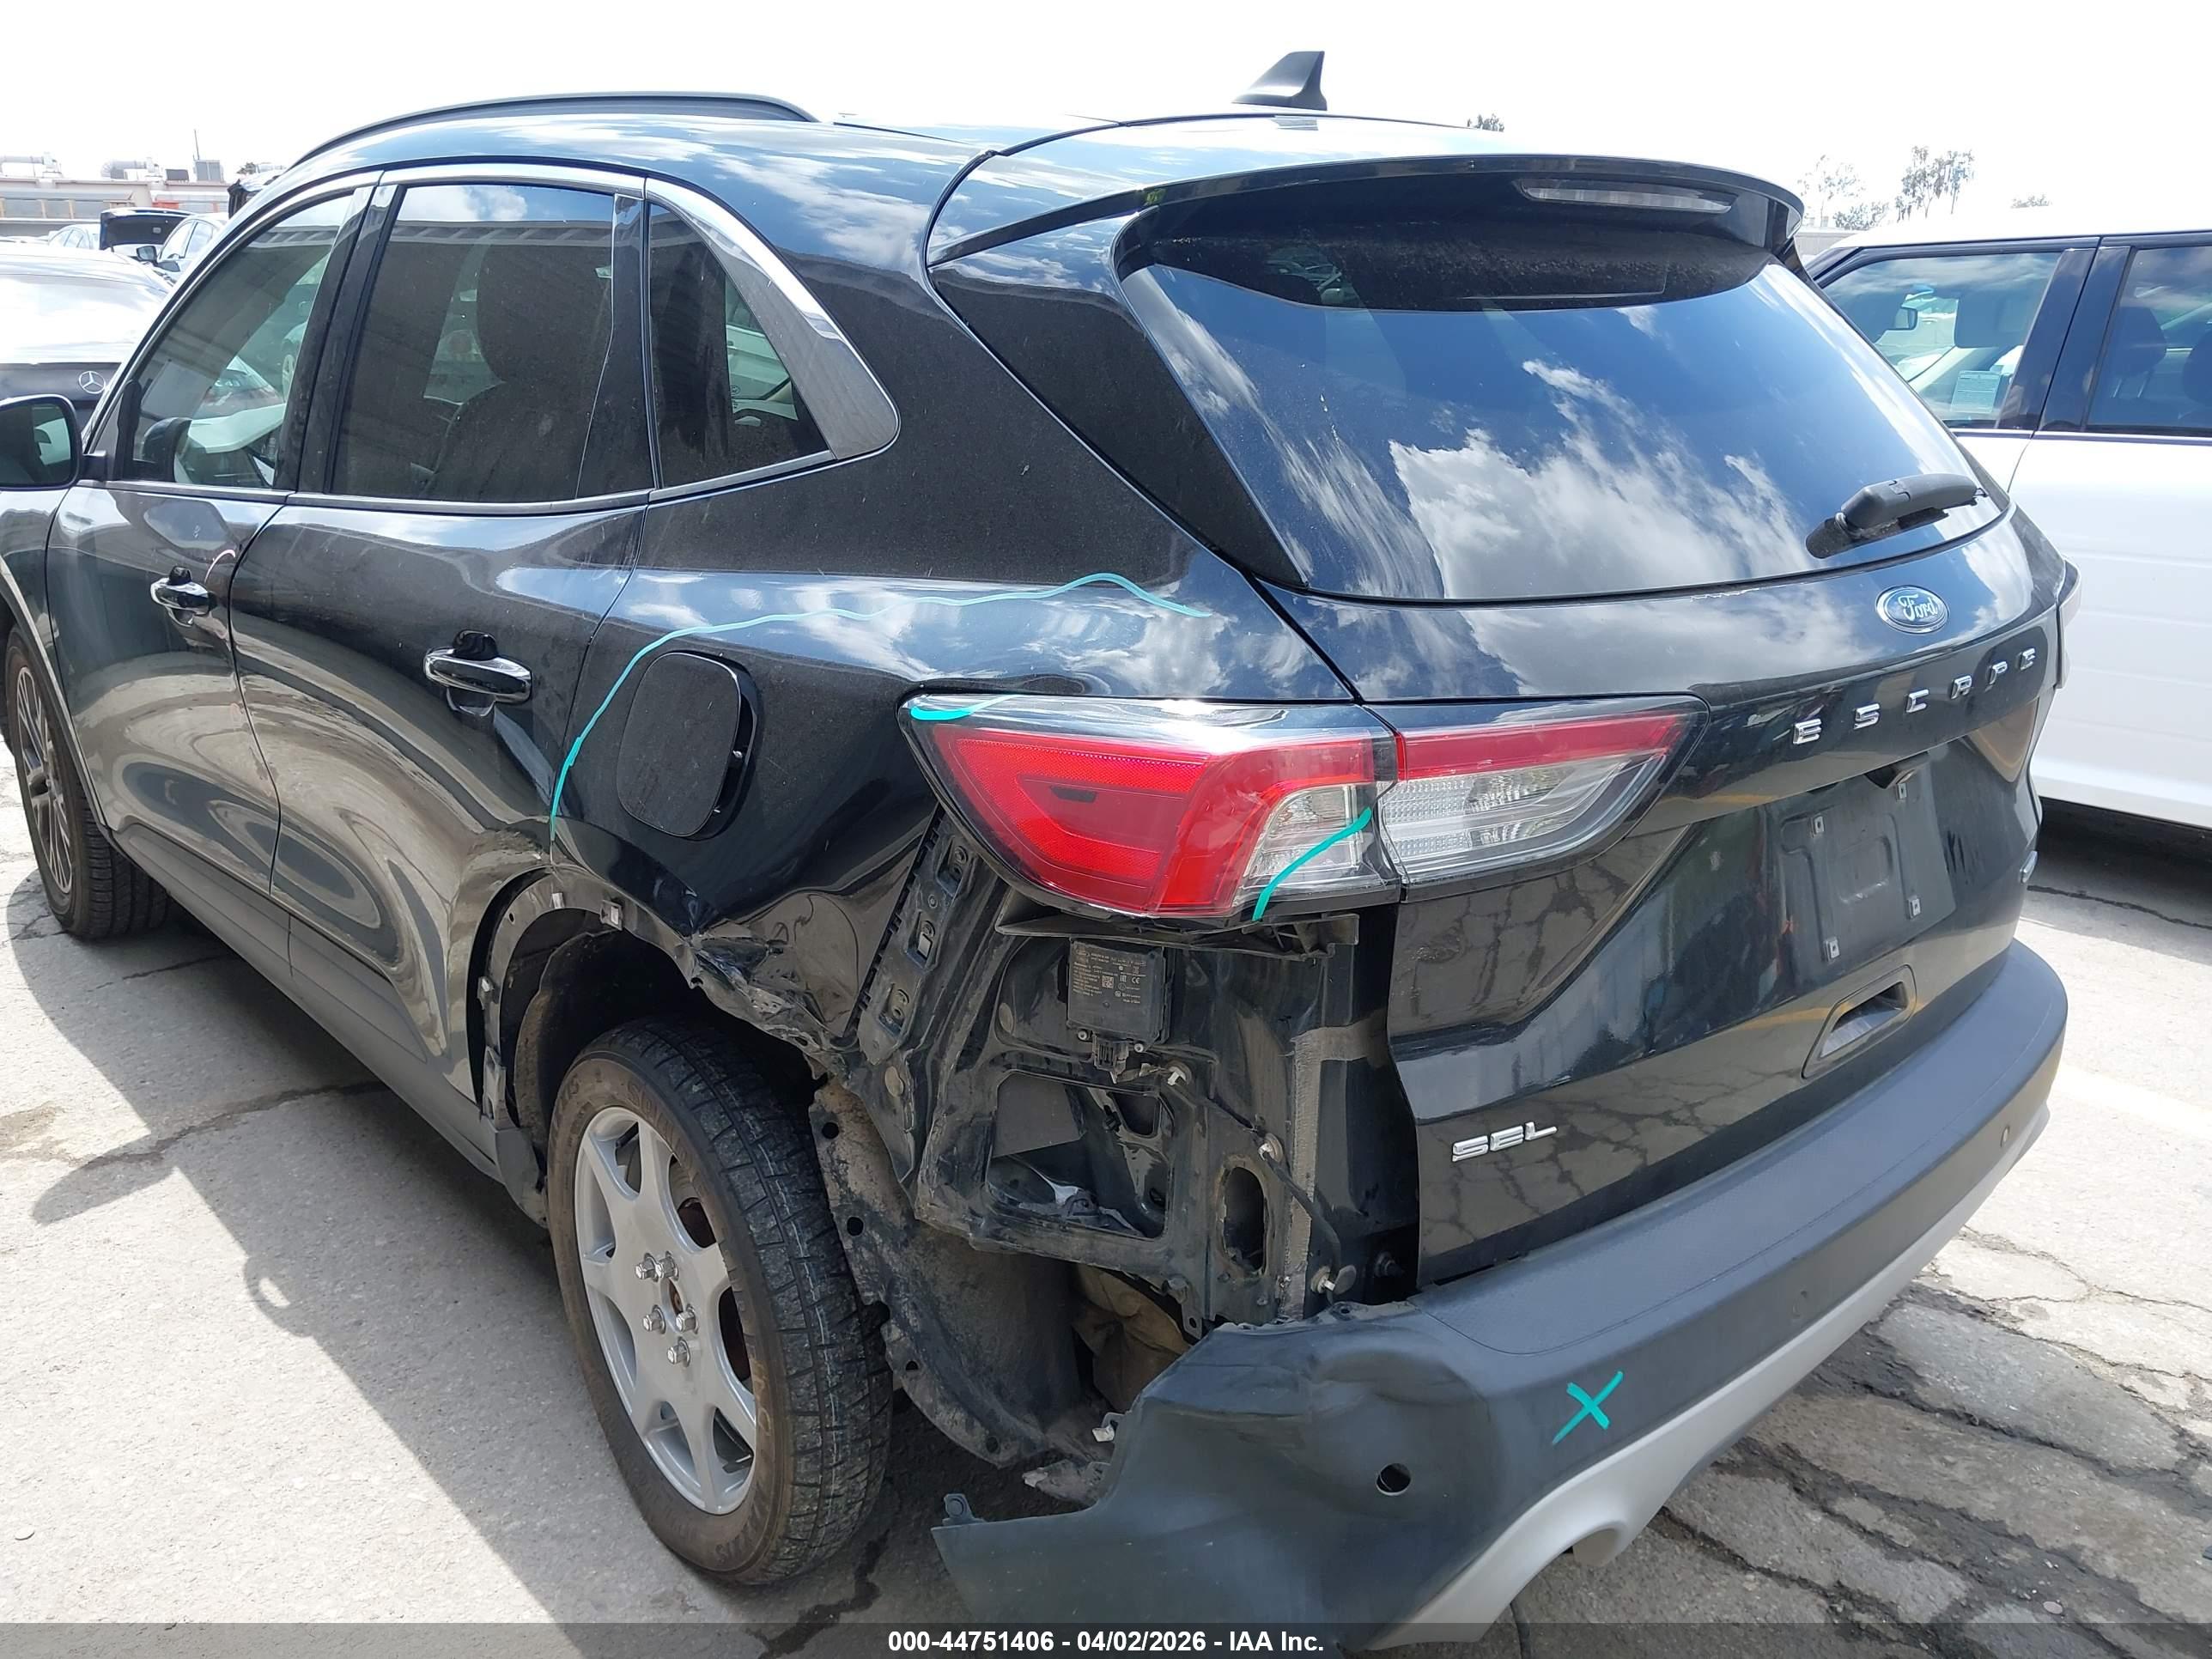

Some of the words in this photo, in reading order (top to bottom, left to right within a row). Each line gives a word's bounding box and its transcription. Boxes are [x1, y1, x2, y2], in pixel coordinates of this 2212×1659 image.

[1898, 593, 1938, 622] Ford
[1793, 647, 2036, 744] ESCAPE
[1452, 1121, 1558, 1162] SEL
